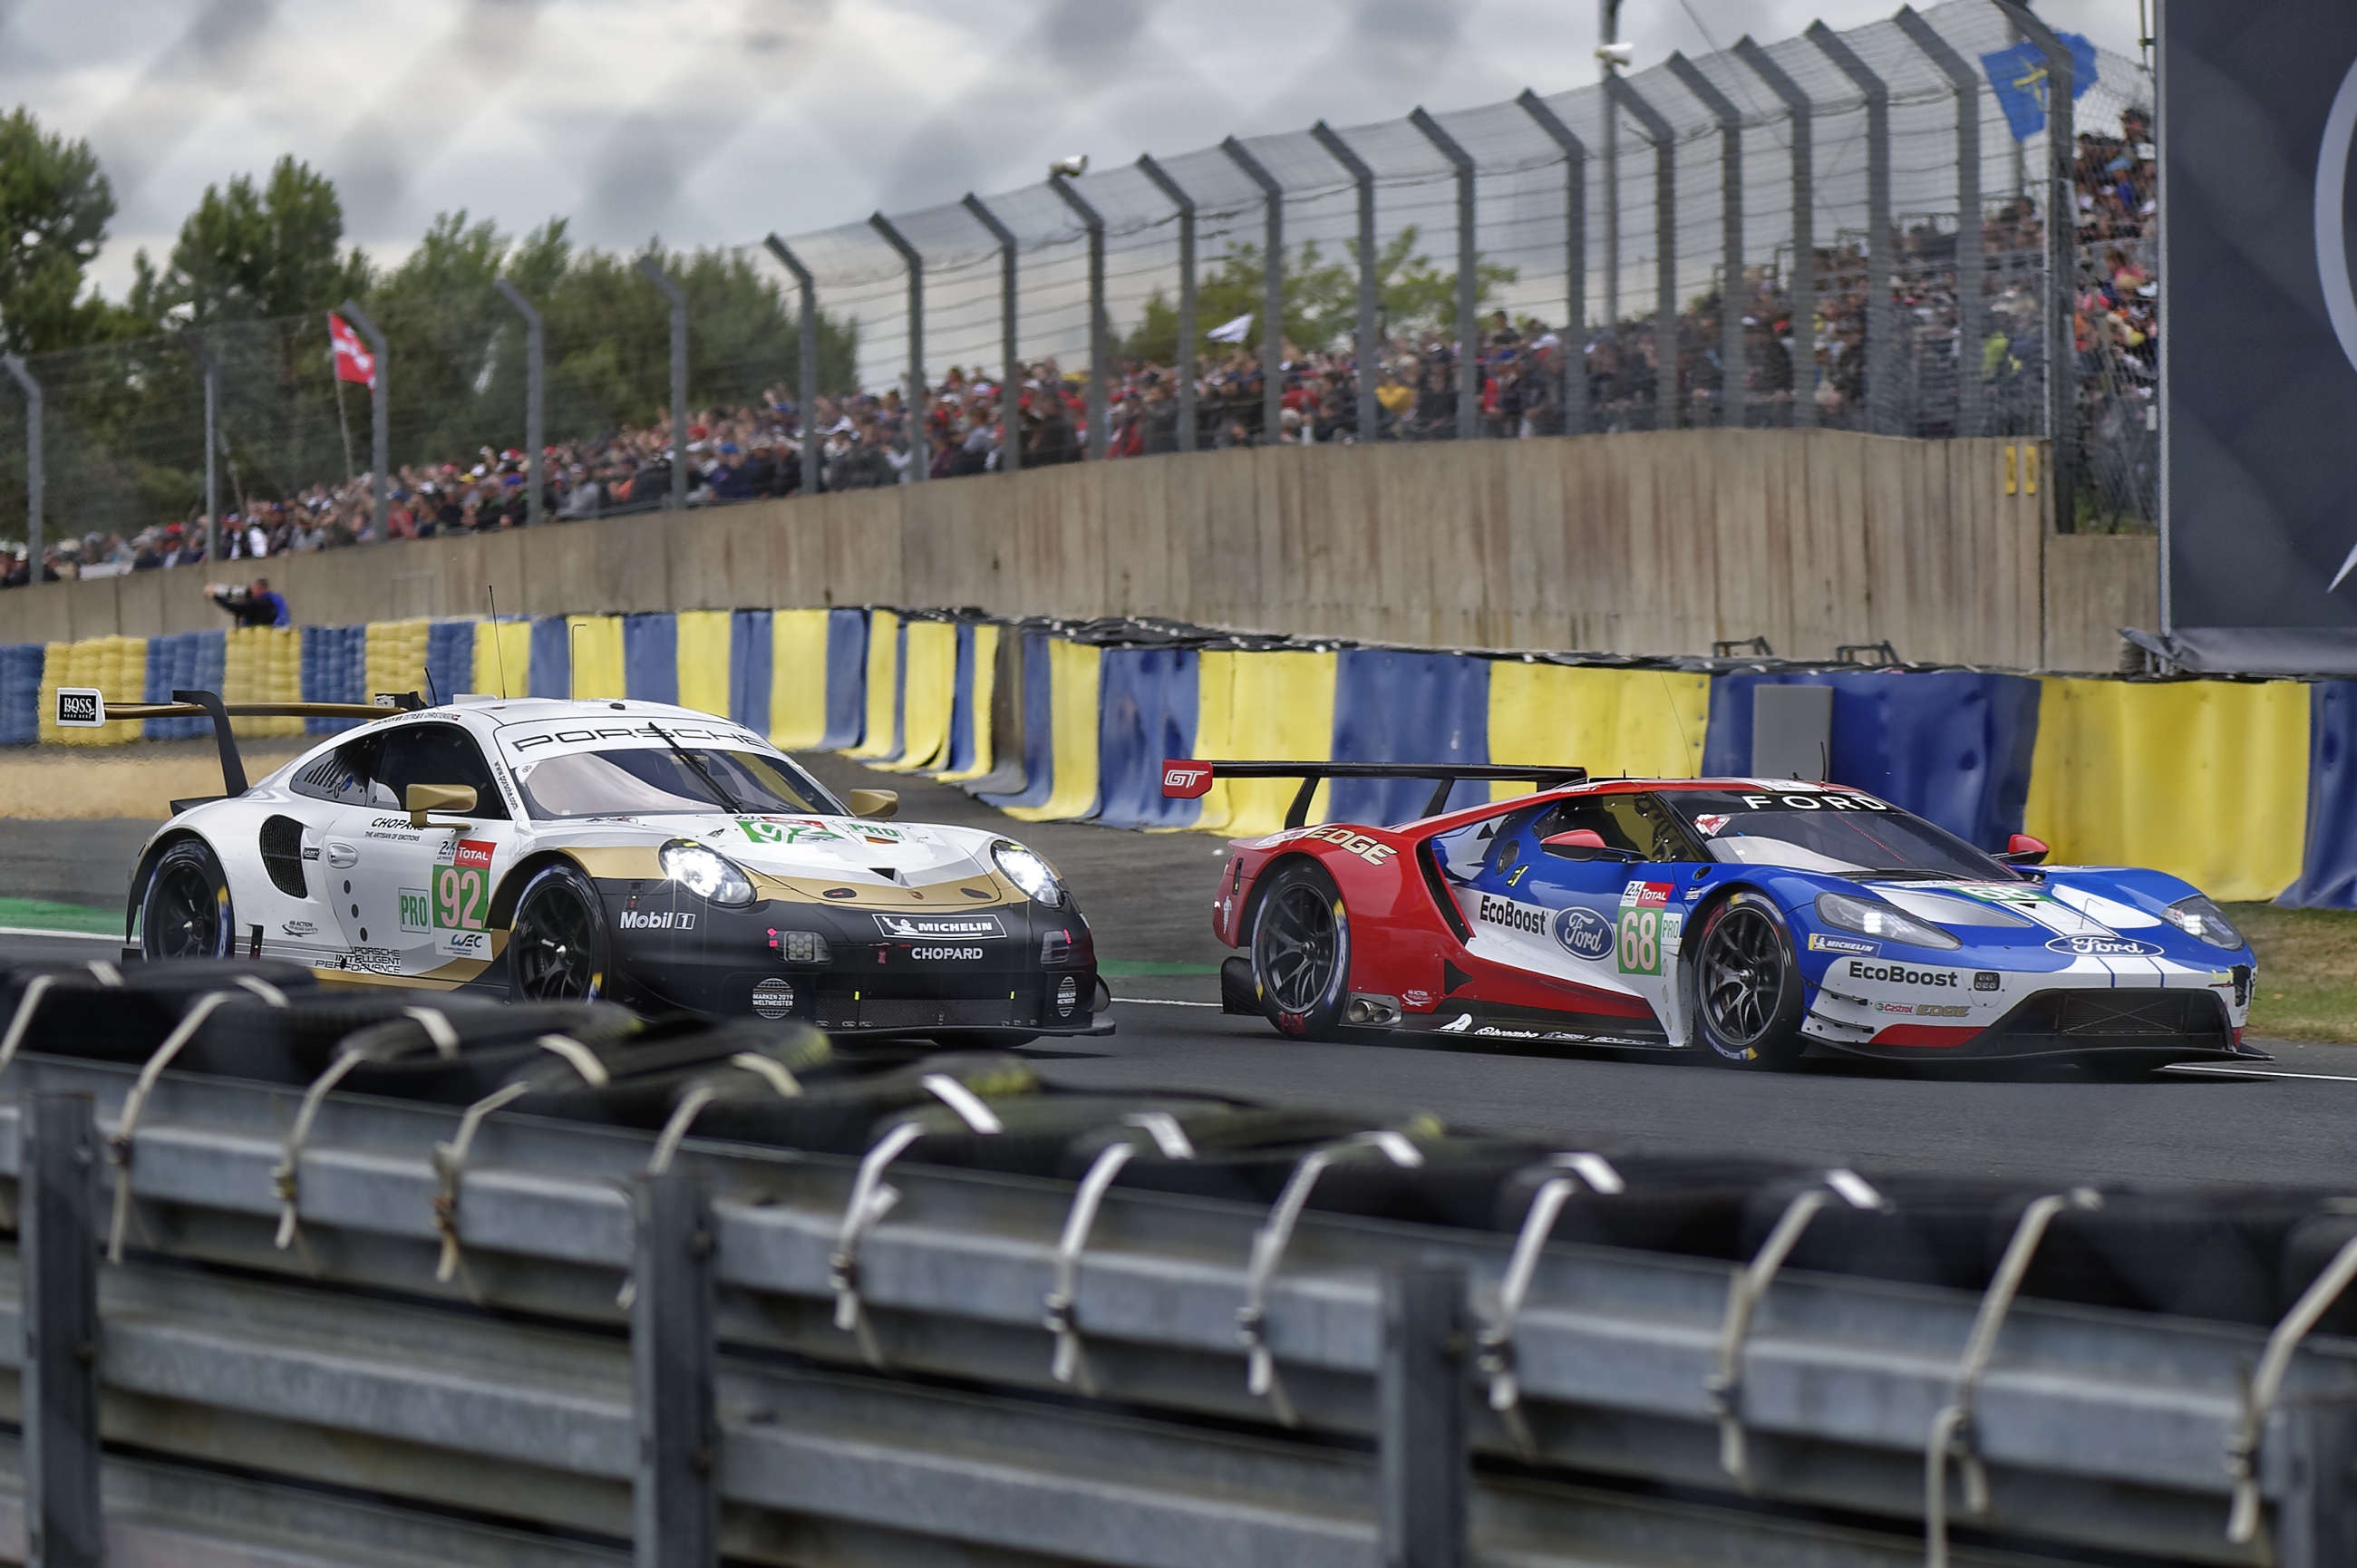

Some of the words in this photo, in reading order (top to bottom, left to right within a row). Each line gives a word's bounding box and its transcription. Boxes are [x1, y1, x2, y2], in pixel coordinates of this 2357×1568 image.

[64, 697, 92, 713] BOSS
[511, 728, 771, 752] PORSCHE
[1164, 769, 1208, 789] GT
[1741, 796, 1887, 810] FORD
[371, 817, 425, 830] CHOPA
[849, 823, 900, 837] PRO
[458, 847, 489, 861] TOTAL
[1305, 828, 1401, 866] EDGE
[439, 868, 482, 930] 92
[1641, 889, 1666, 900] TOTAL
[401, 895, 427, 926] PRO
[1479, 895, 1547, 935] EcoBoost
[620, 911, 674, 929] Mobil
[917, 922, 993, 932] MICHELIN
[1565, 912, 1603, 952] Ford
[1662, 919, 1680, 939] PRO
[451, 934, 482, 948] WEC
[1621, 911, 1656, 971] 68
[1826, 936, 1875, 953] MICHELIN
[2071, 936, 2144, 953] Ford
[335, 953, 401, 965] INTELLIGENT
[354, 946, 401, 957] PORSCHE
[911, 947, 983, 960] CHOPARD
[315, 959, 401, 974] PERFORMANCE
[1848, 961, 1958, 987] EcoBoost
[1885, 1003, 1914, 1013] Castrol
[1916, 1004, 1973, 1018] EDGE
[1491, 1028, 1540, 1038] brembo
